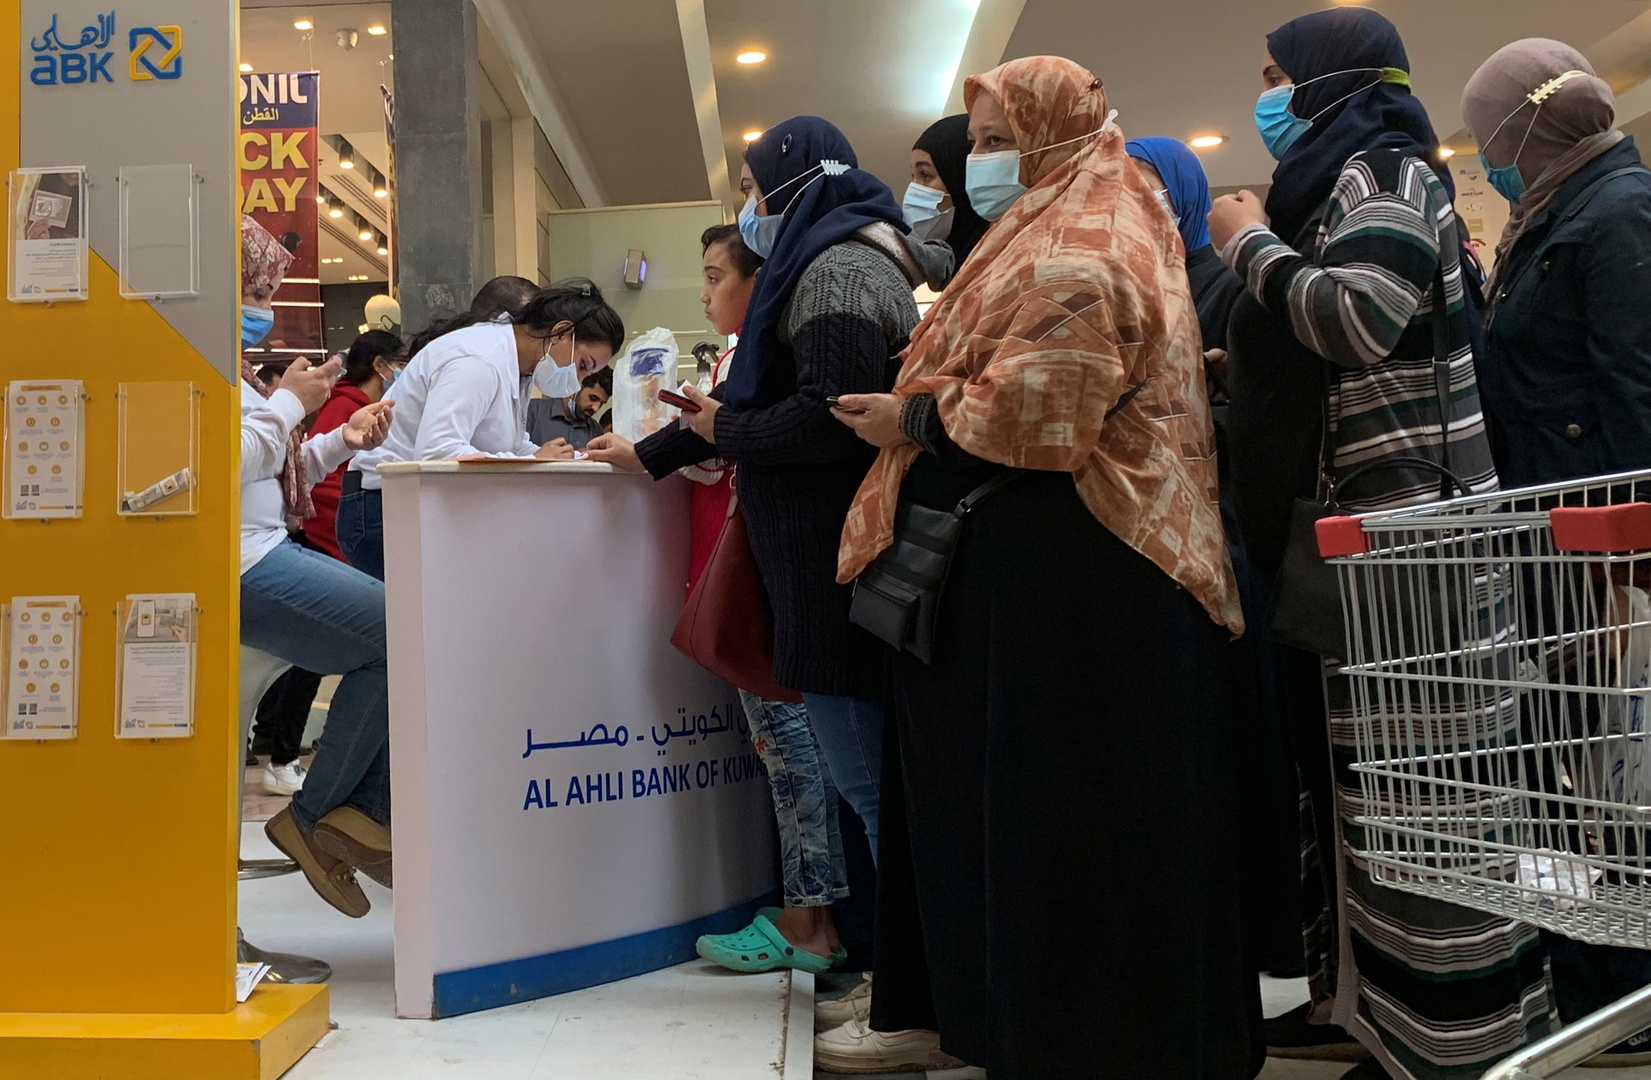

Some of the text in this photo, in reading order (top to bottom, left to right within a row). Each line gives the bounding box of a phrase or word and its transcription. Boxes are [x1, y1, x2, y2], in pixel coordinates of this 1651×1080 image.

[240, 74, 307, 104] NIL
[243, 107, 279, 125] القطن
[240, 176, 307, 212] AY
[522, 723, 629, 759] مصر
[652, 703, 734, 756] الكويتي
[523, 778, 558, 811] AL
[566, 771, 624, 806] AHLI
[632, 763, 690, 798] BANK
[696, 759, 719, 789] OF
